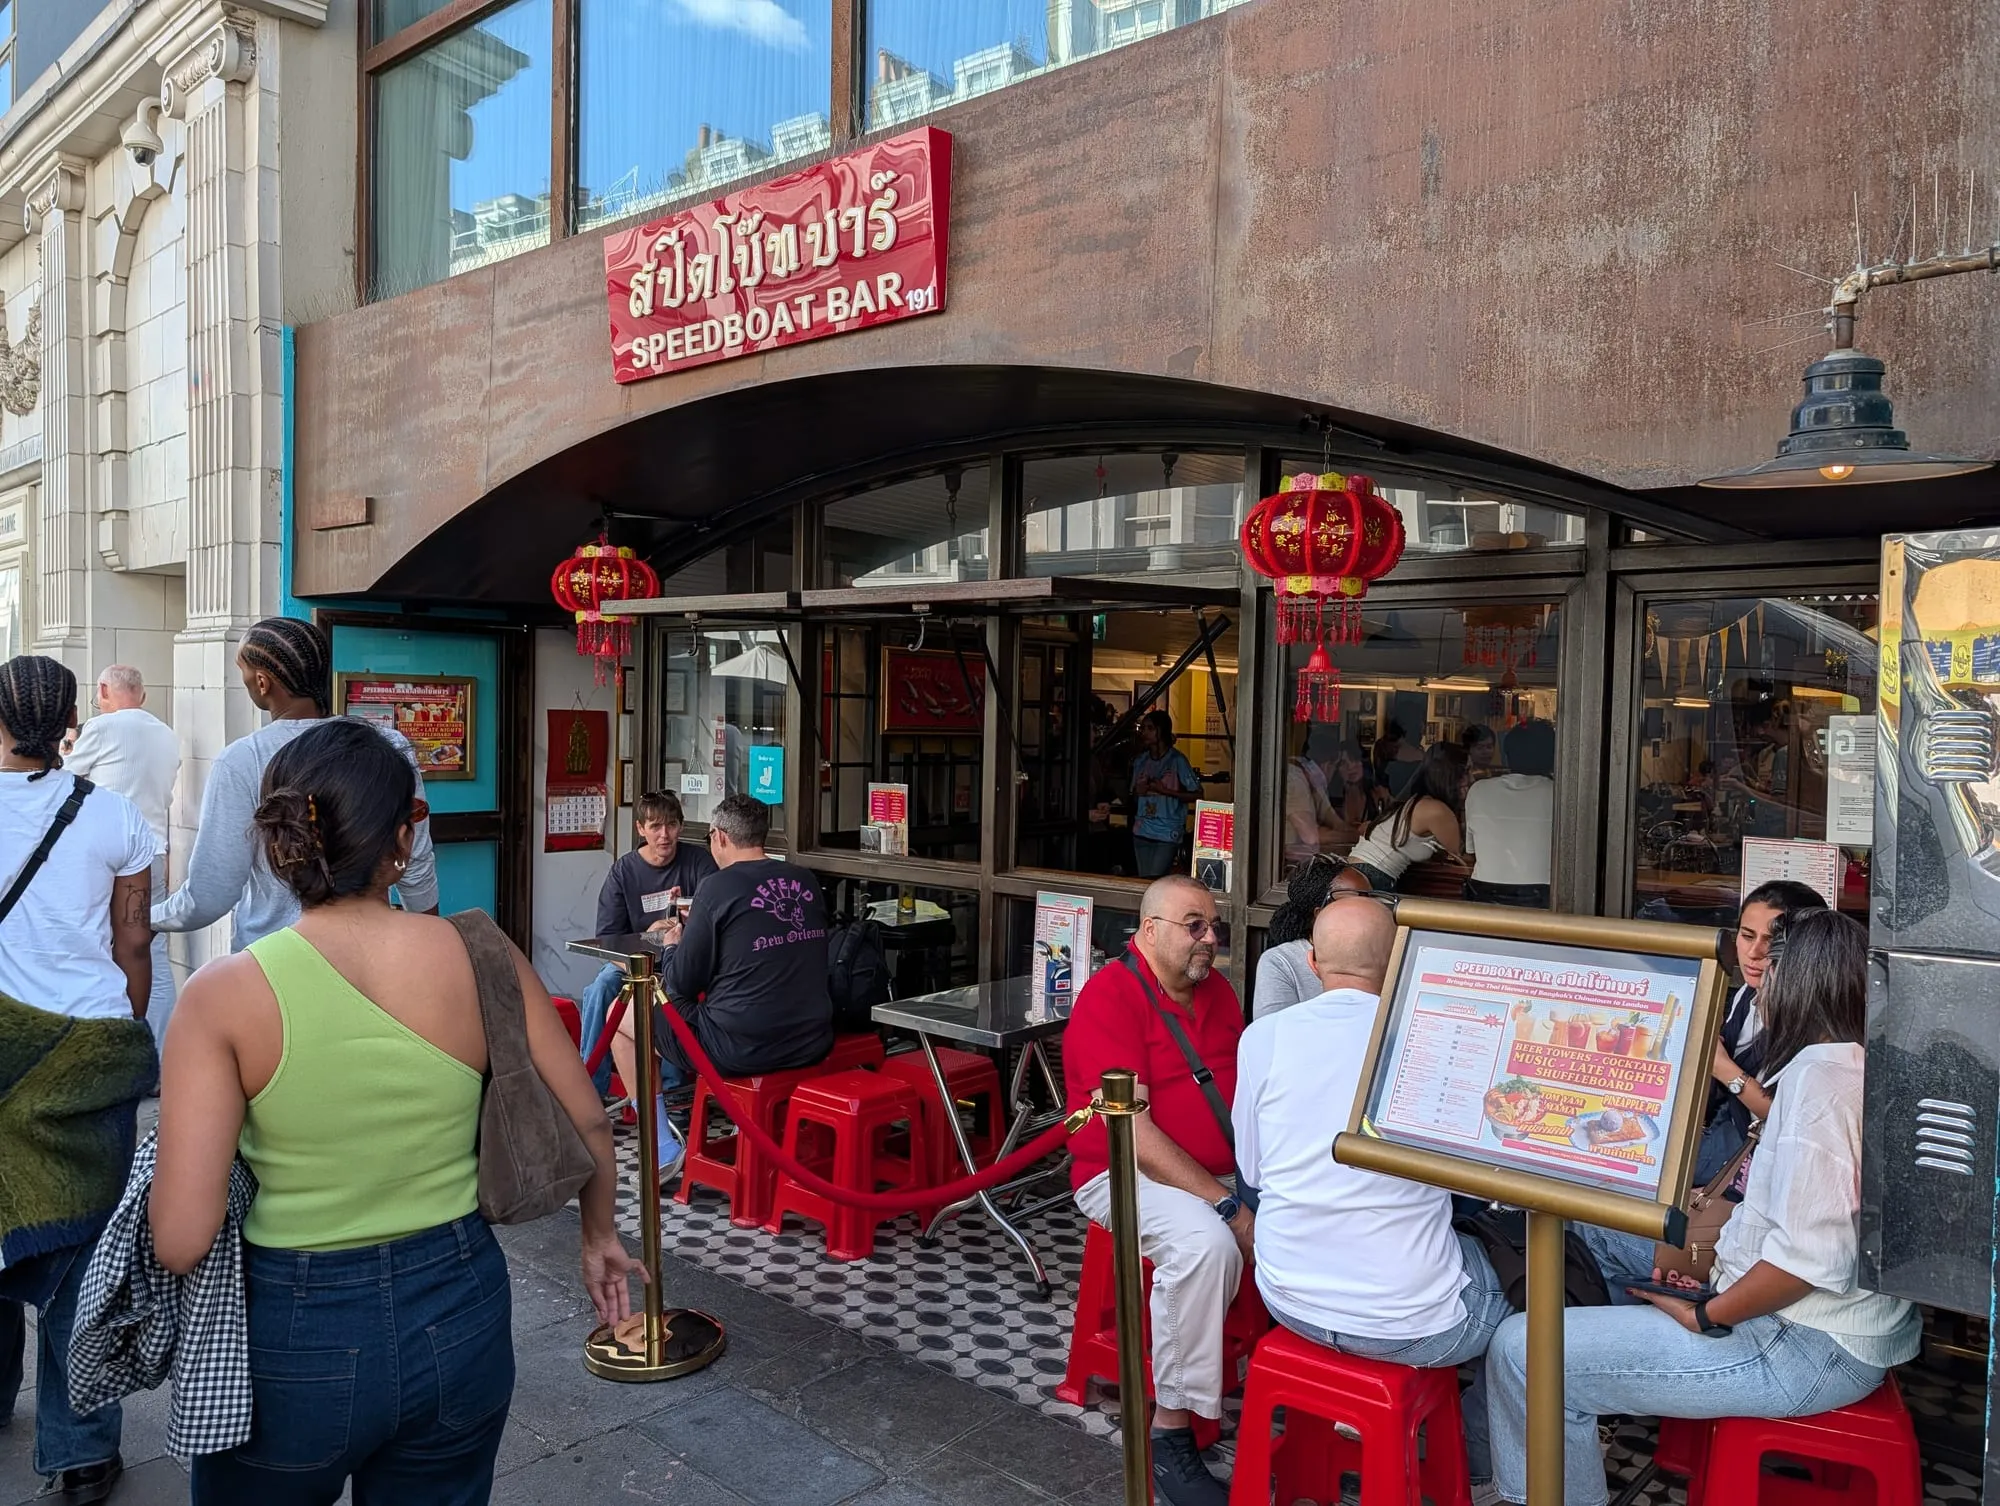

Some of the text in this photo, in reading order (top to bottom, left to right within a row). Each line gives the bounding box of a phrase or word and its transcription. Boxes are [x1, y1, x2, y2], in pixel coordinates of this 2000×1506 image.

[631, 272, 936, 369] SPEEDBOAT BAR 191
[362, 686, 395, 694] SPEEDBOAT
[751, 878, 813, 908] DEFEND
[752, 928, 825, 952] New Orleans
[1454, 961, 1553, 985] SPEEDBOAT BAR
[1446, 978, 1474, 989] Bringing
[1474, 981, 1486, 989] the
[1486, 983, 1500, 991] Thai
[1501, 984, 1529, 995] Flavours
[1530, 987, 1537, 996] of
[1574, 994, 1612, 1006] Chinatown
[1613, 999, 1621, 1007] to
[1621, 1000, 1649, 1010] London
[1512, 1052, 1557, 1068] MUSIC
[1569, 1061, 1605, 1076] LATE
[1608, 1067, 1665, 1087] NIGHTS
[1514, 1042, 1543, 1054] BEER
[1545, 1046, 1592, 1063] TOWERS
[1602, 1056, 1667, 1074] COCKTAILS
[1535, 1067, 1634, 1093] SHUFFLEBOARD
[1540, 1091, 1585, 1107] TOM YAM
[1544, 1102, 1577, 1115] MAMA
[1603, 1094, 1661, 1115] PINEAPPLE PIE
